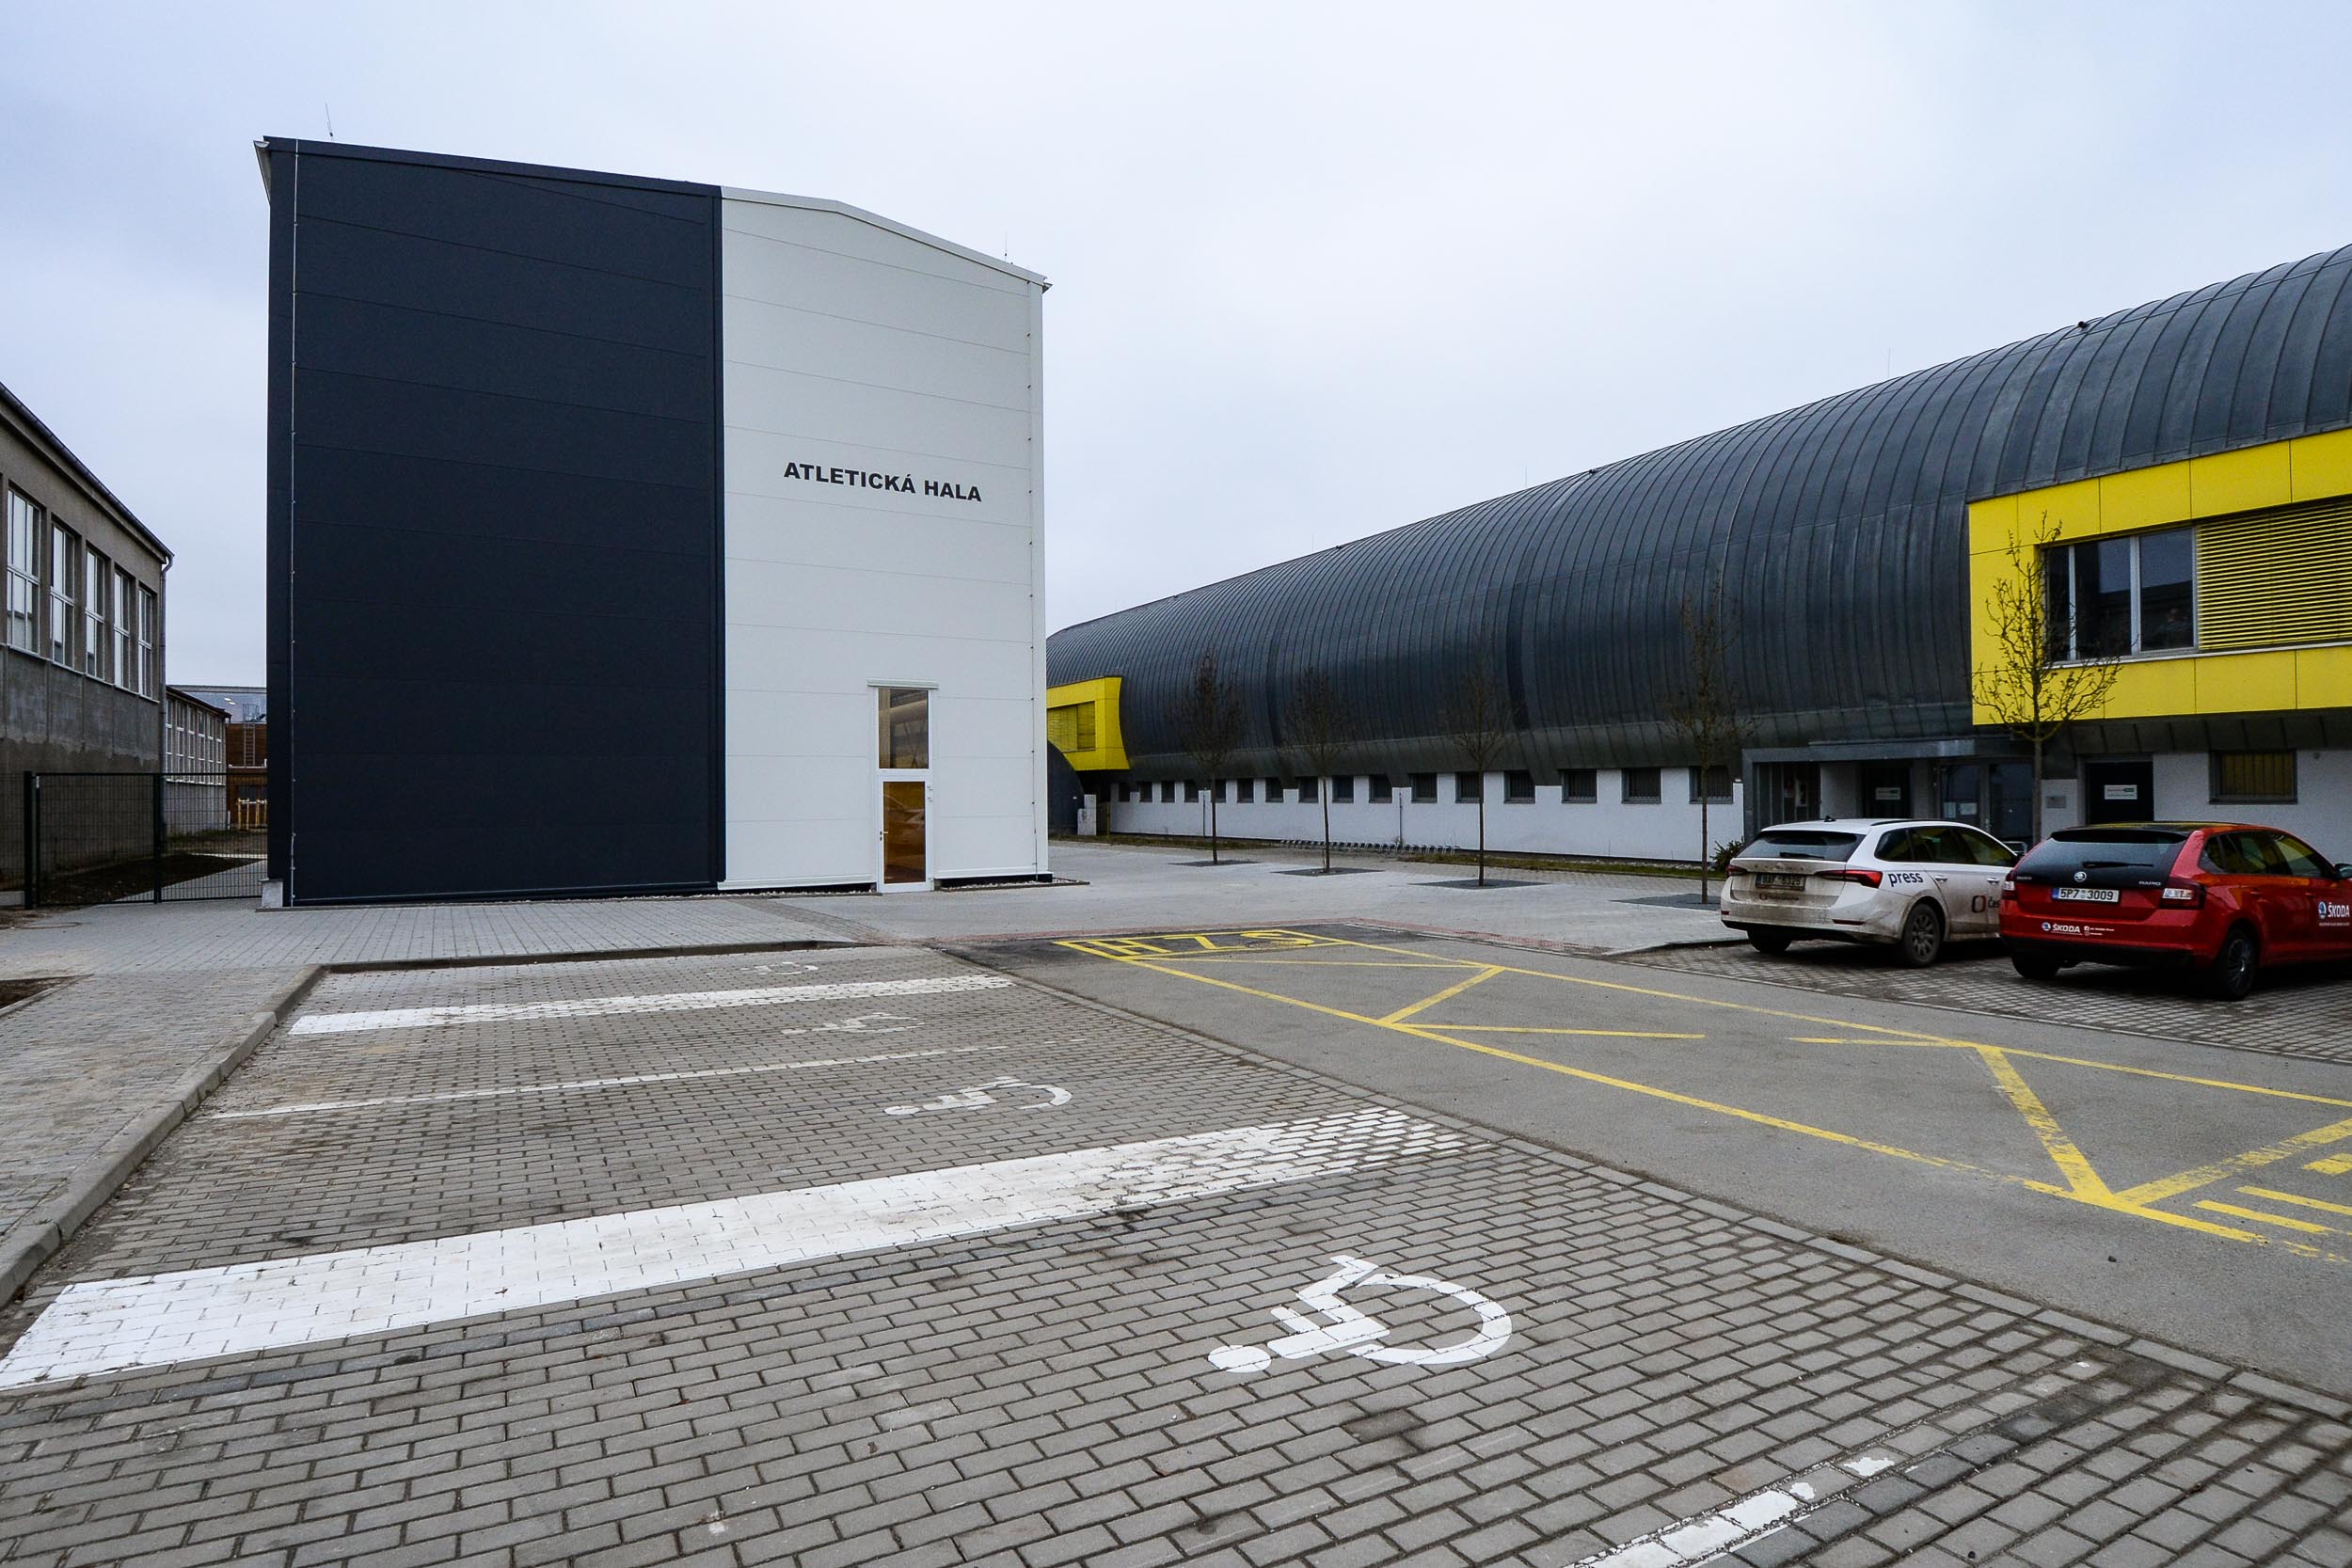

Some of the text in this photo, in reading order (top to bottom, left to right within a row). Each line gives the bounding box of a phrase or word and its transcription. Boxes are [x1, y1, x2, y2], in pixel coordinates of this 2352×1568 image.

[784, 462, 982, 502] ATLETICKÁ HALA
[1887, 873, 1924, 887] press
[2060, 889, 2114, 900] 5P7 3009
[2328, 901, 2350, 918] ŠKODA
[2052, 923, 2081, 933] ŠKODA
